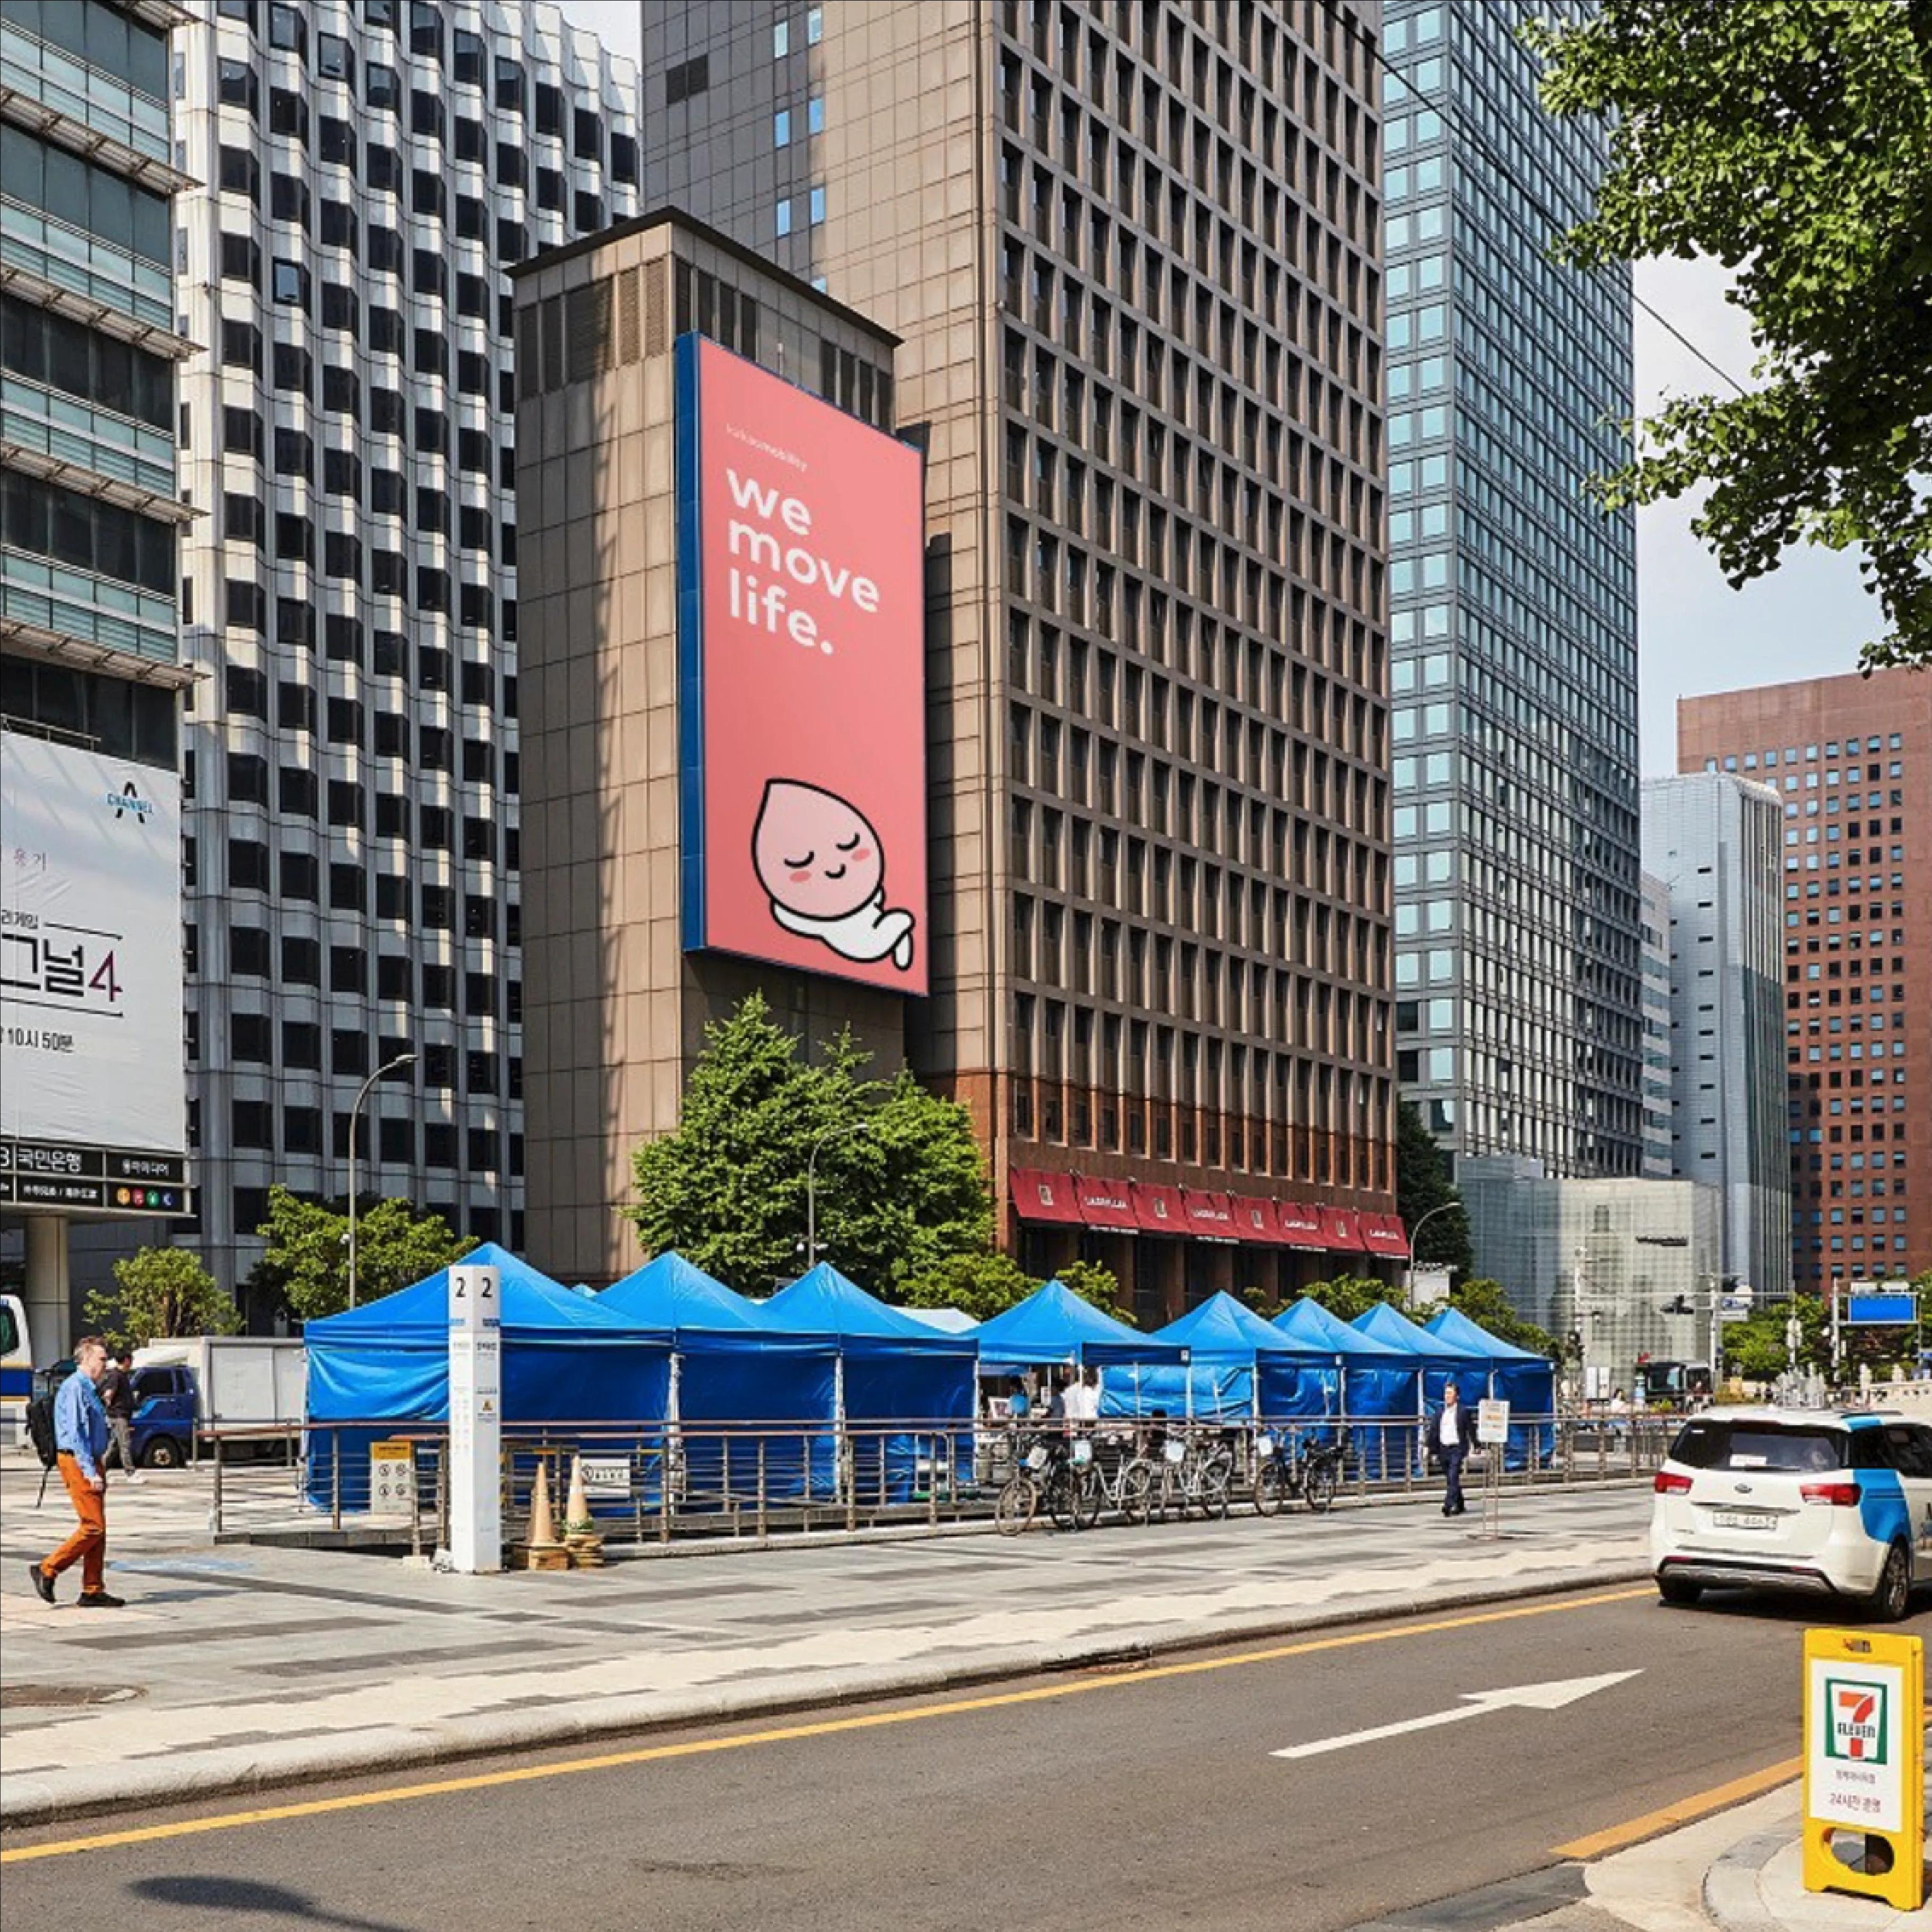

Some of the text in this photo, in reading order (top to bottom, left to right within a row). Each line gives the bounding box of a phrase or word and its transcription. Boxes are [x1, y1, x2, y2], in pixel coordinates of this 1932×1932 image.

[726, 467, 812, 535] we
[729, 519, 880, 613] move
[730, 568, 833, 655] life.
[8, 1027, 39, 1049] 10시
[18, 1147, 82, 1173] 국민은행
[455, 1276, 466, 1298] 2
[481, 1276, 493, 1298] 2
[1839, 1691, 1875, 1757] 7
